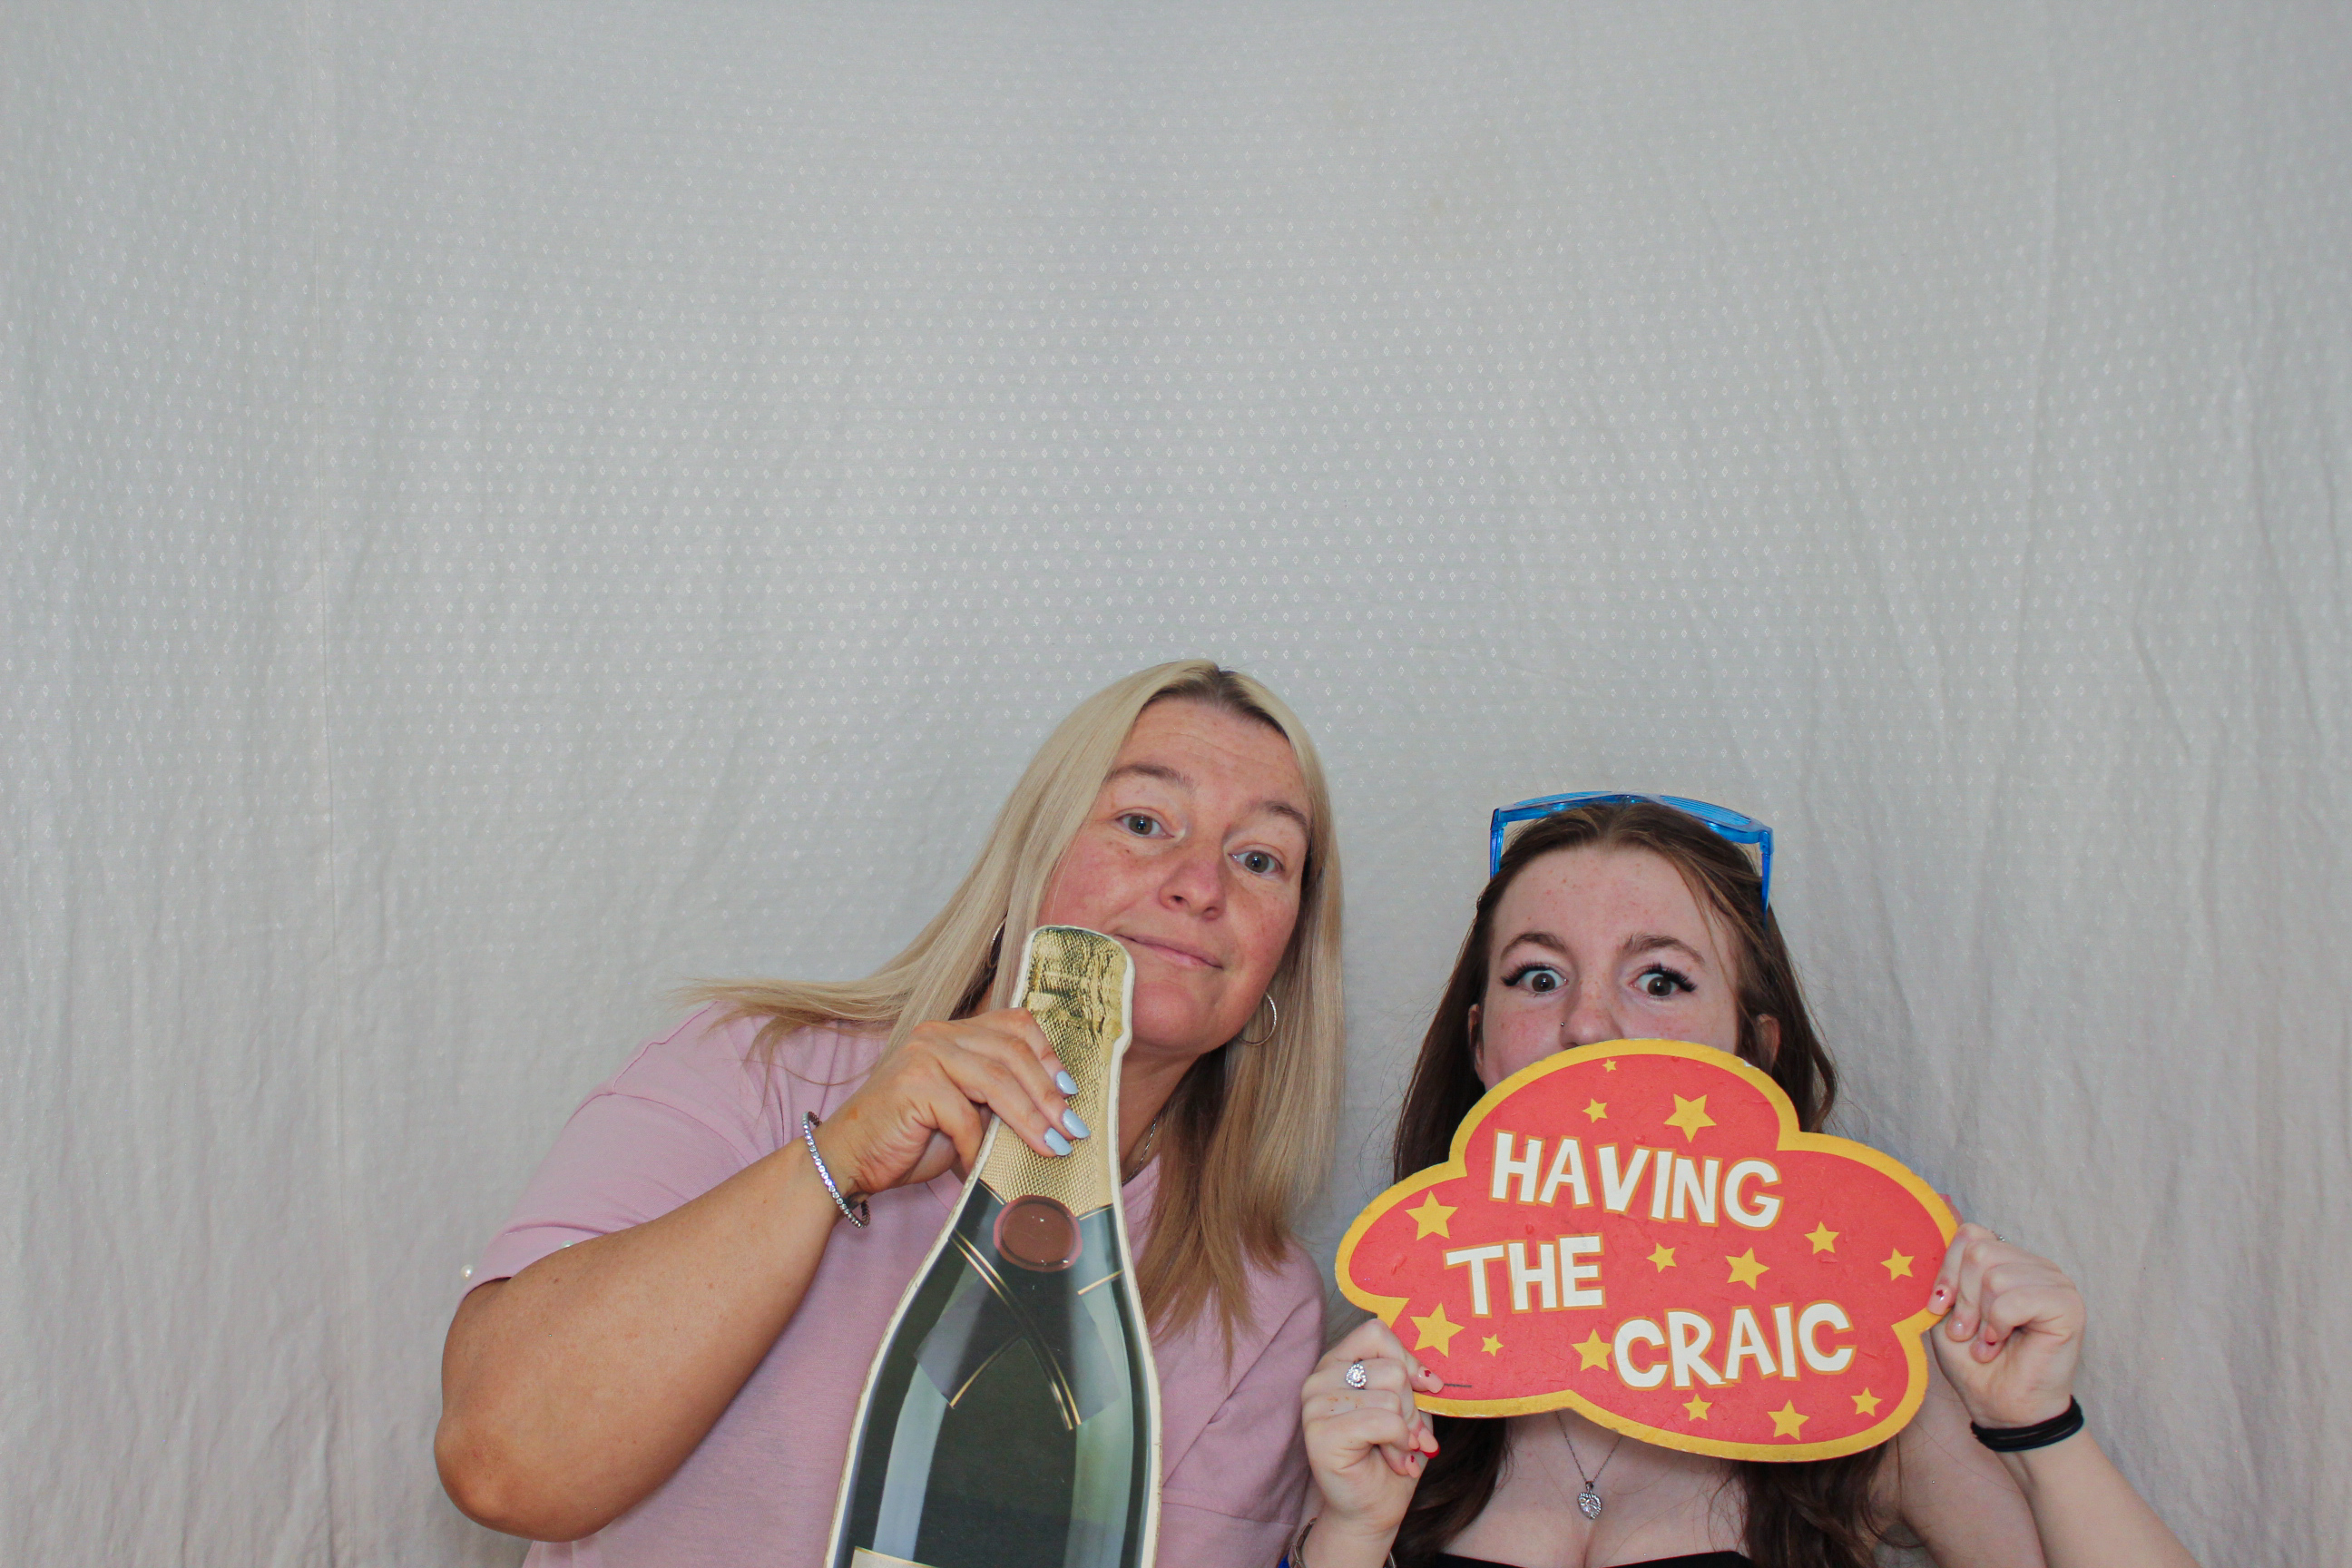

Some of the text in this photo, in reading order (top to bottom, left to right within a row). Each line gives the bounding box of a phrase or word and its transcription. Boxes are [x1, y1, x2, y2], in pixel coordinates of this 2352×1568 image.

[1491, 1131, 1781, 1229] HAVING
[1445, 1234, 1604, 1316] THE
[1612, 1302, 1854, 1388] CRAIC
